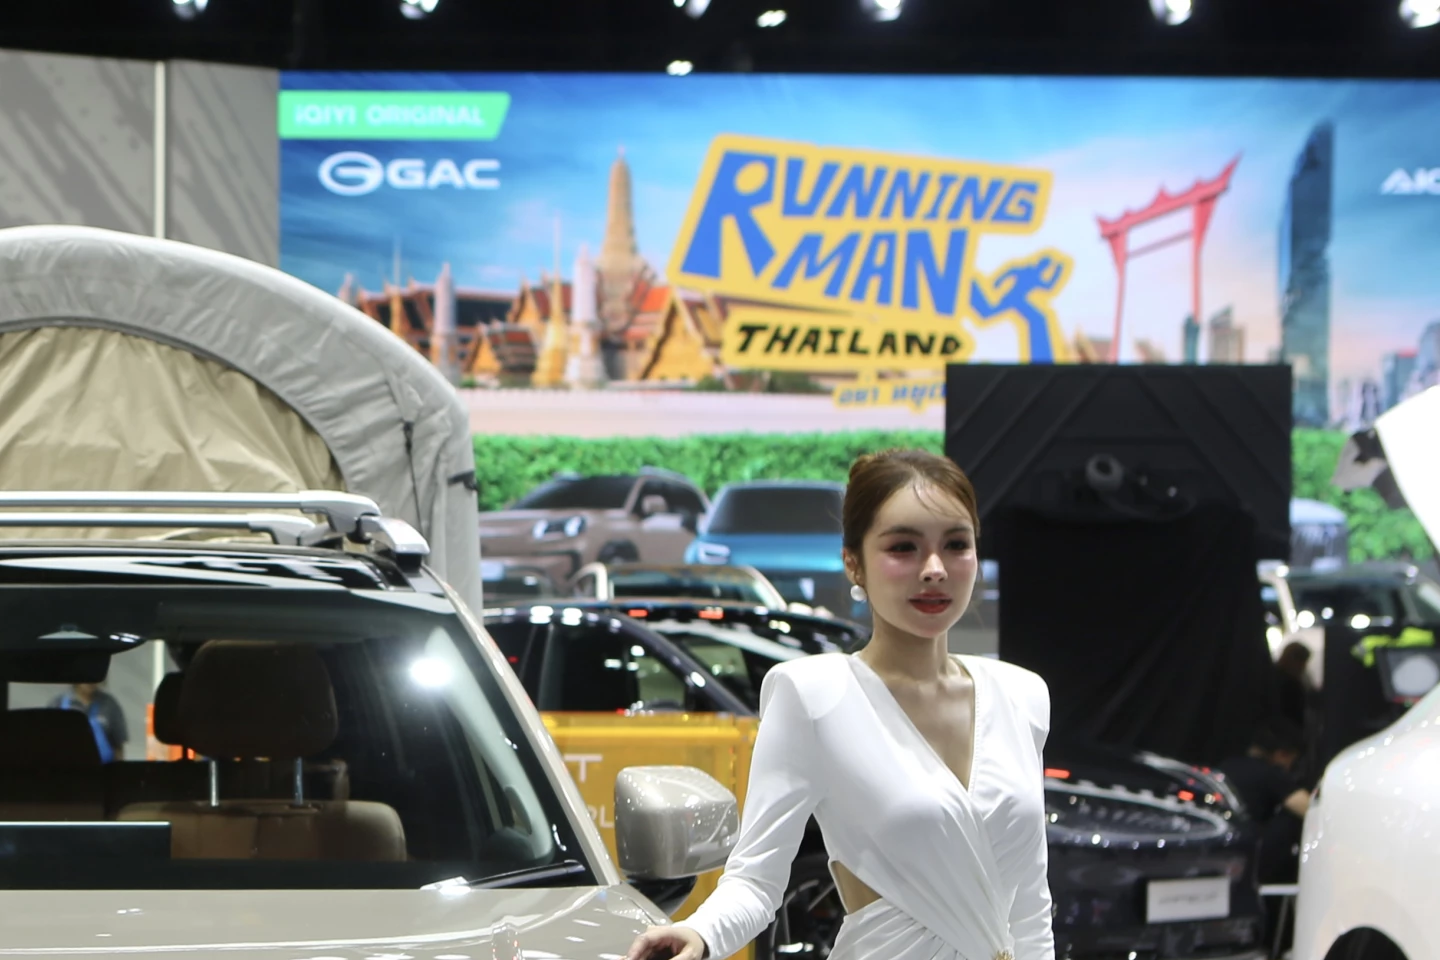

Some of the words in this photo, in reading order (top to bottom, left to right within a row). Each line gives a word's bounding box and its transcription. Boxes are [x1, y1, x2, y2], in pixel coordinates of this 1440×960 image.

[294, 104, 357, 127] iQIYI
[365, 104, 486, 127] ORIGINAL
[386, 158, 501, 190] GAC
[679, 150, 1041, 279] RUNNING
[769, 228, 969, 318] MAN
[734, 323, 965, 358] THAILAND
